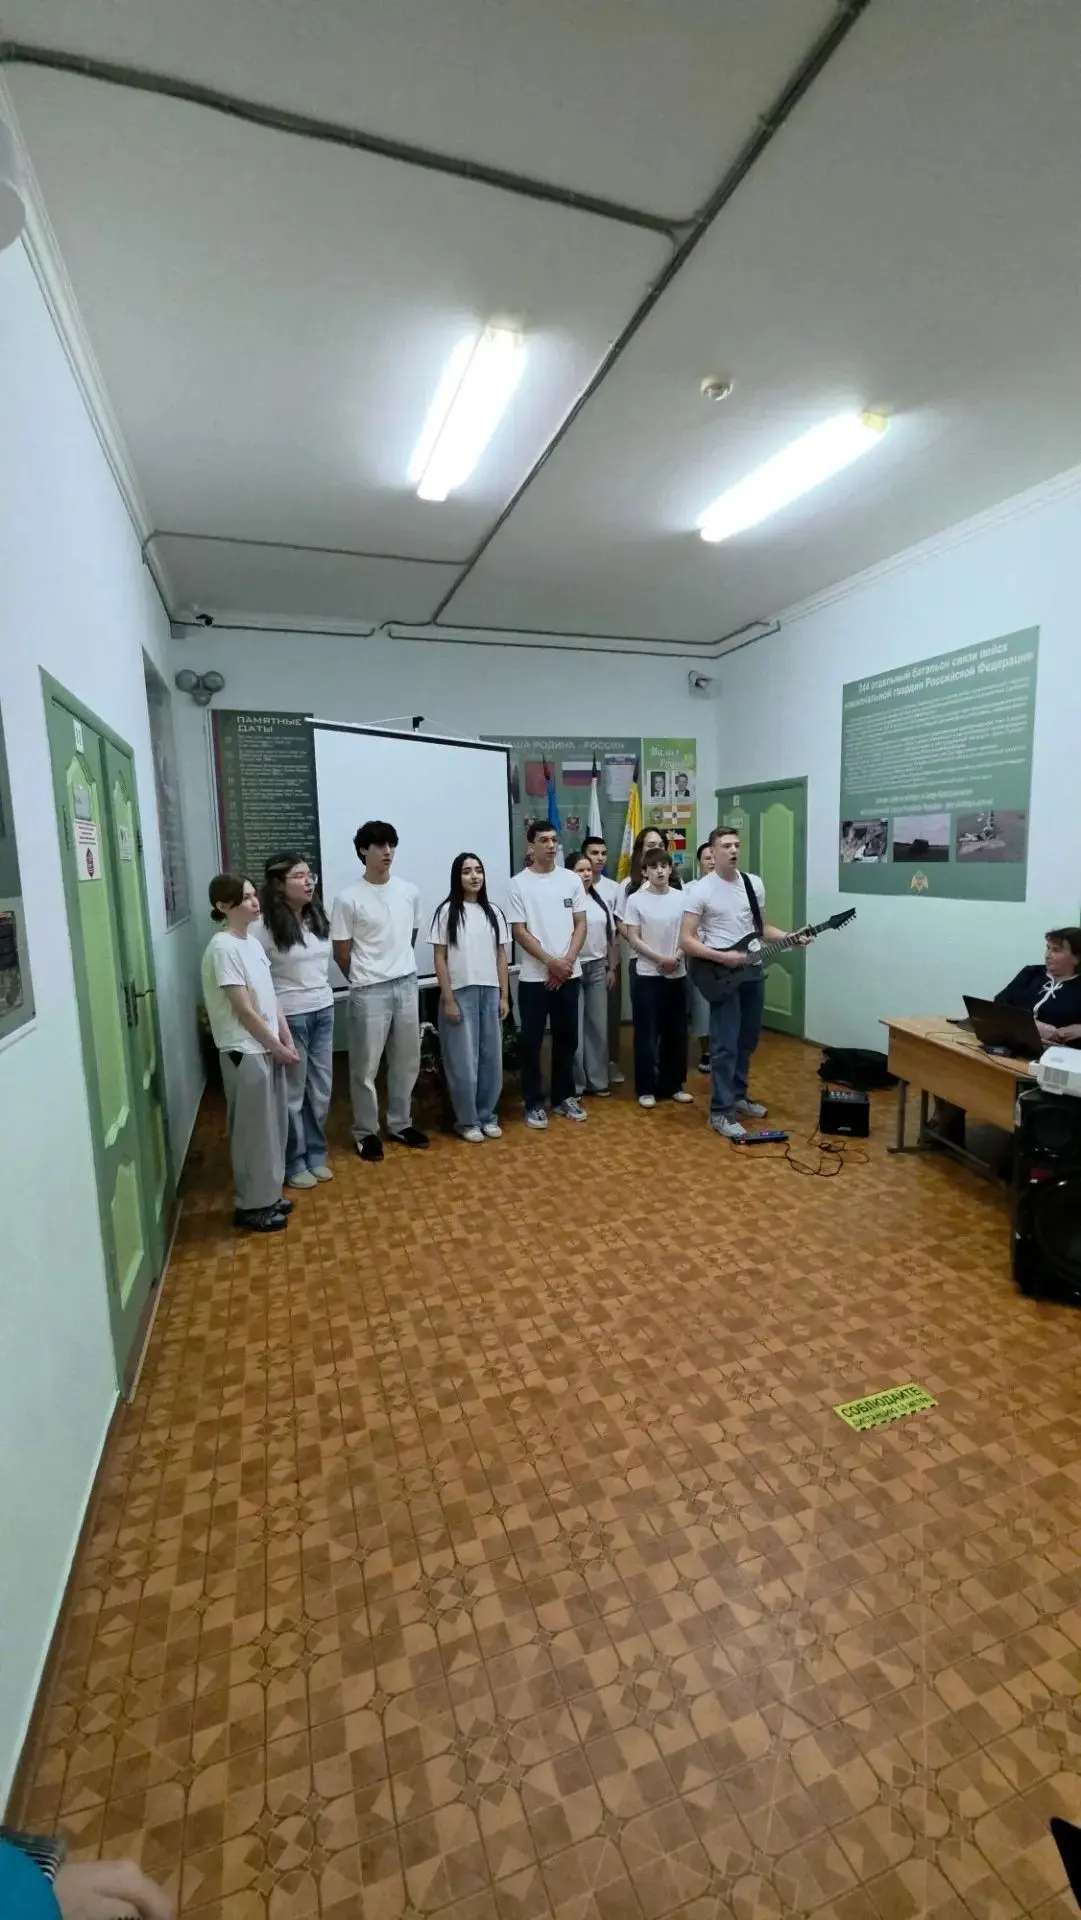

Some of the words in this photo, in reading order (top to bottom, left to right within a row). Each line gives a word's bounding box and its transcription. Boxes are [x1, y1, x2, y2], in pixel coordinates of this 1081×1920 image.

[912, 659, 950, 678] батальон
[952, 652, 978, 668] связи
[925, 668, 975, 688] Российской
[237, 716, 302, 726] ПАМЯТНЫЕ
[238, 725, 273, 733] ДАТЫ
[533, 740, 575, 750] РОДИНА
[841, 1386, 921, 1418] СОБЛЮДАЙТЕ
